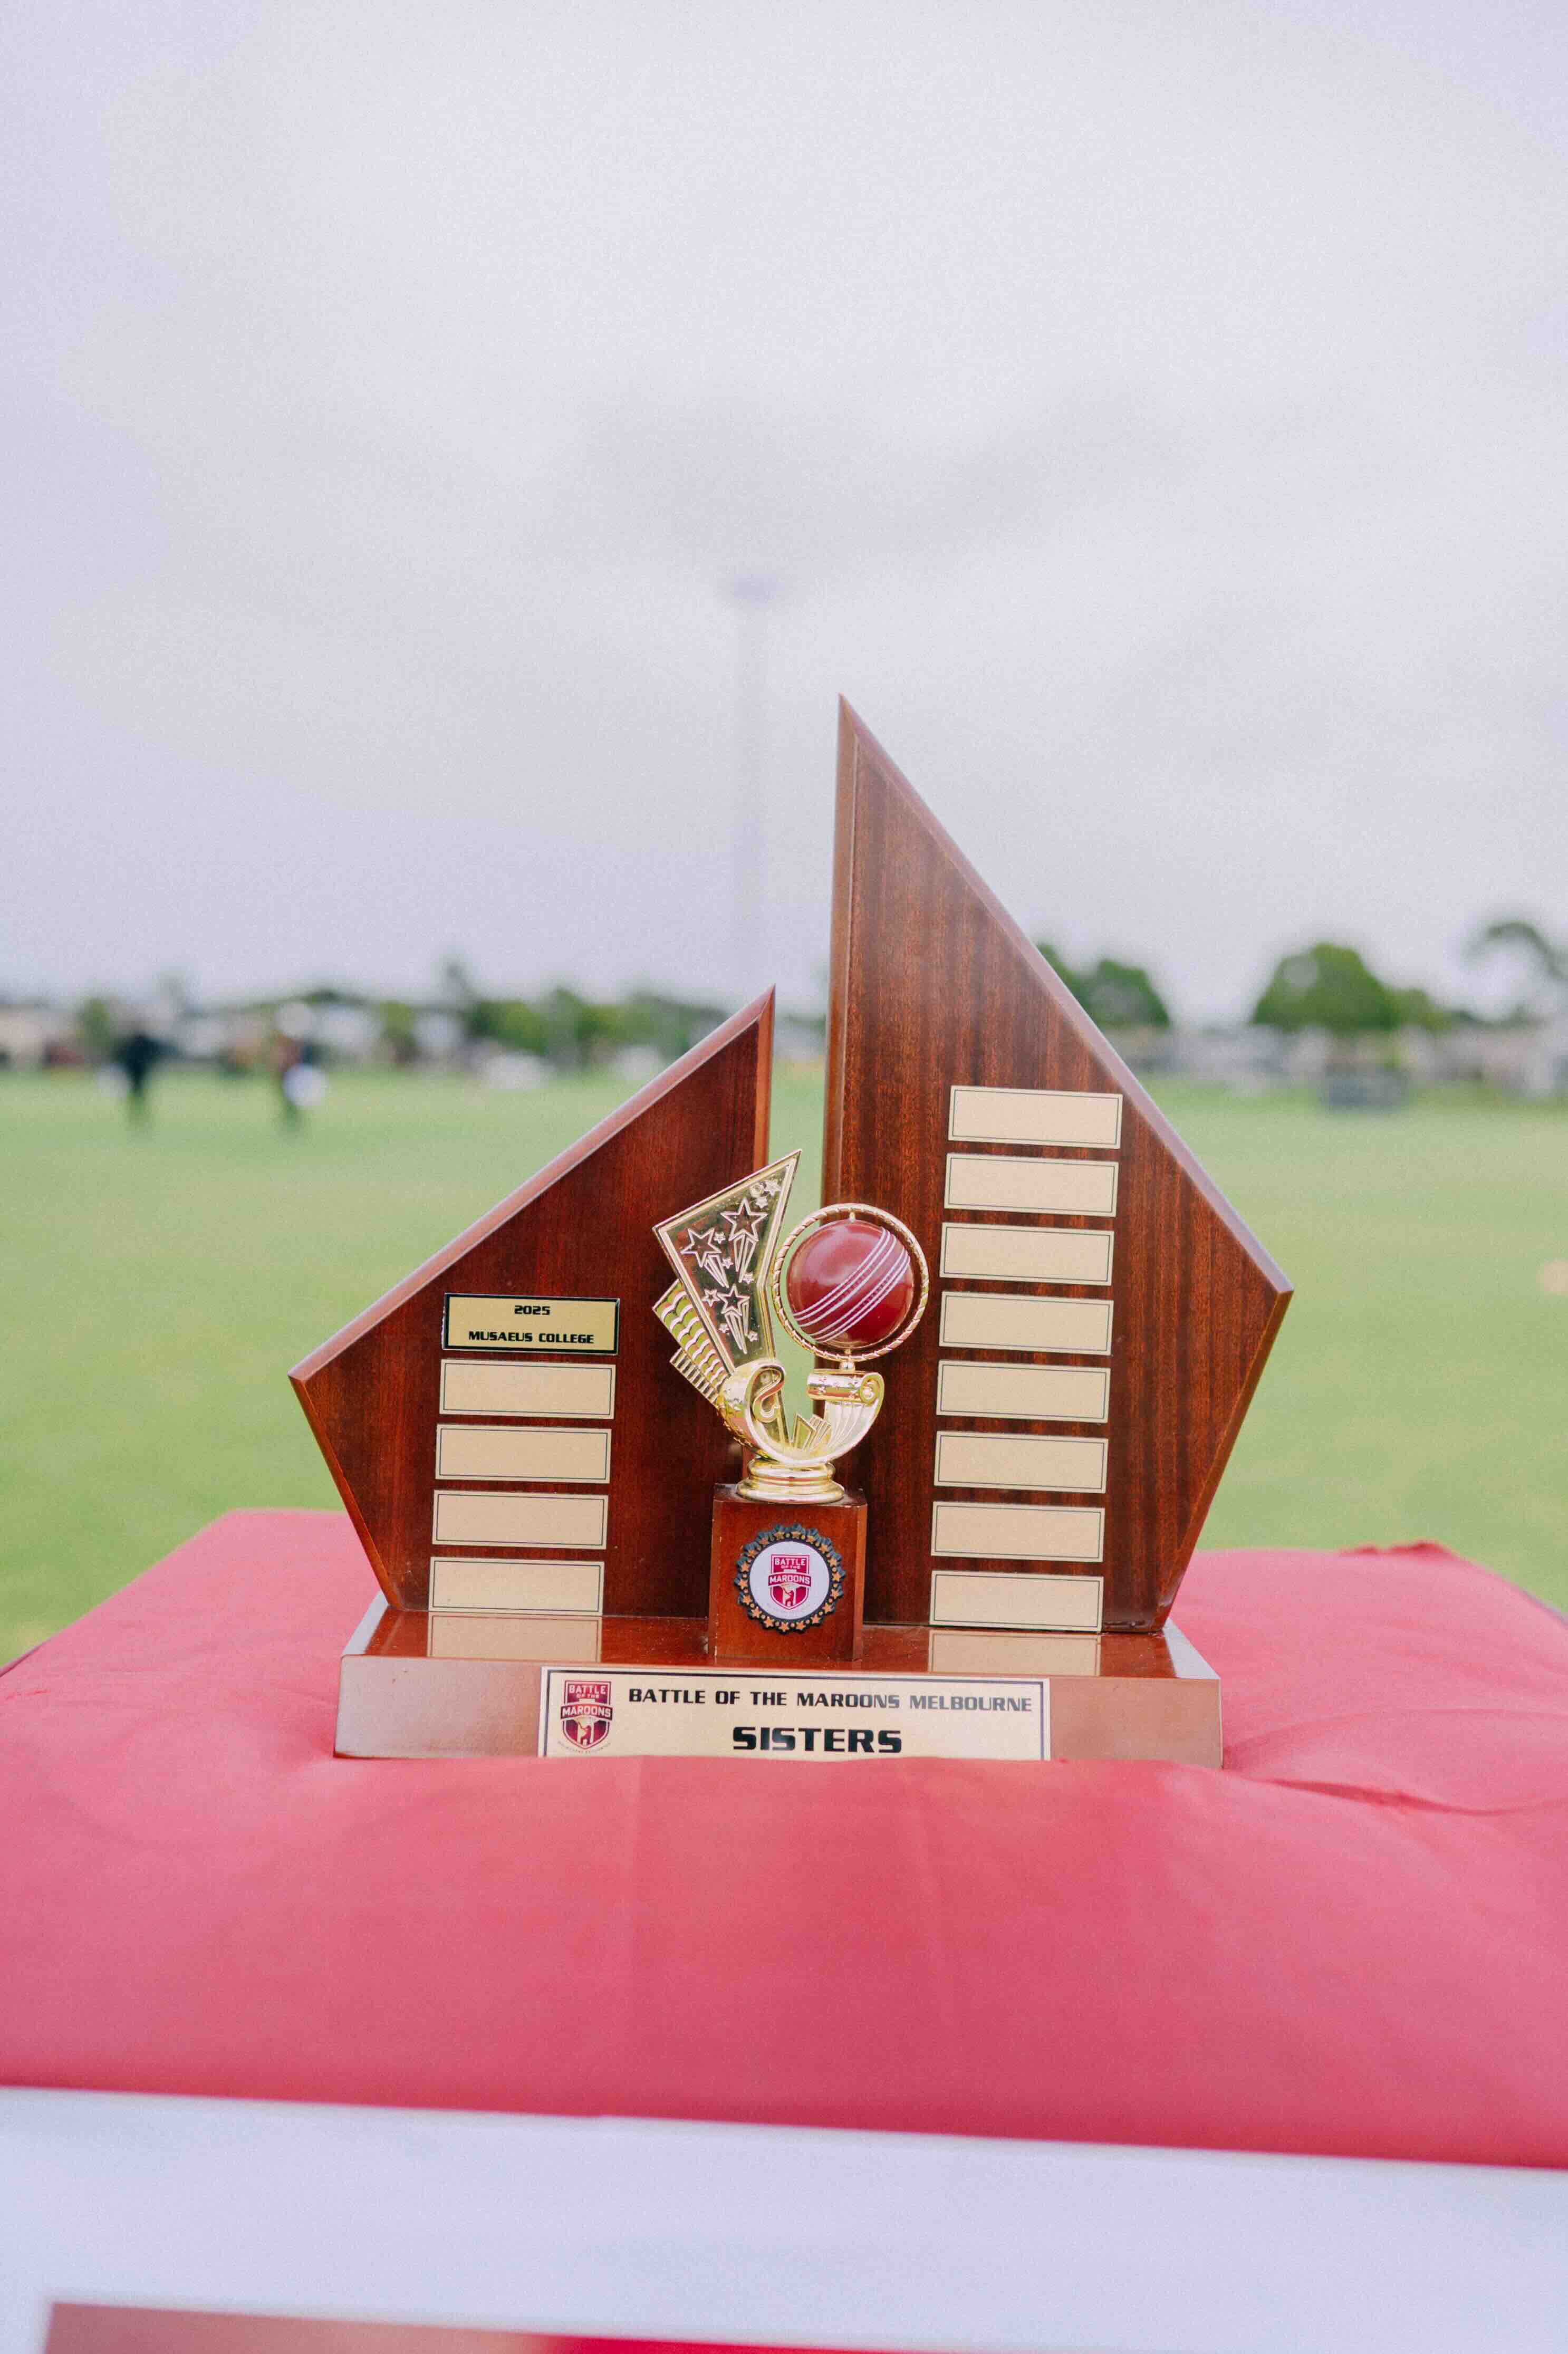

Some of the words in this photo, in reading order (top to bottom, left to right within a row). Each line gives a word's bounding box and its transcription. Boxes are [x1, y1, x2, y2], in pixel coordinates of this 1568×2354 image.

[514, 1305, 551, 1315] 2025
[468, 1331, 533, 1342] MUSAEUS
[538, 1333, 594, 1344] COLLEGE
[774, 1558, 806, 1566] BATTLE
[769, 1574, 811, 1584] MAROONS
[569, 1684, 607, 1695] BATTLE
[629, 1688, 705, 1704] BATTLE
[715, 1690, 740, 1705] OF
[749, 1692, 787, 1706] THE
[797, 1693, 900, 1709] MAROONS
[910, 1695, 1032, 1712] MELBOURNE
[562, 1705, 611, 1718] MAROONS
[733, 1726, 902, 1753] SISTERS
